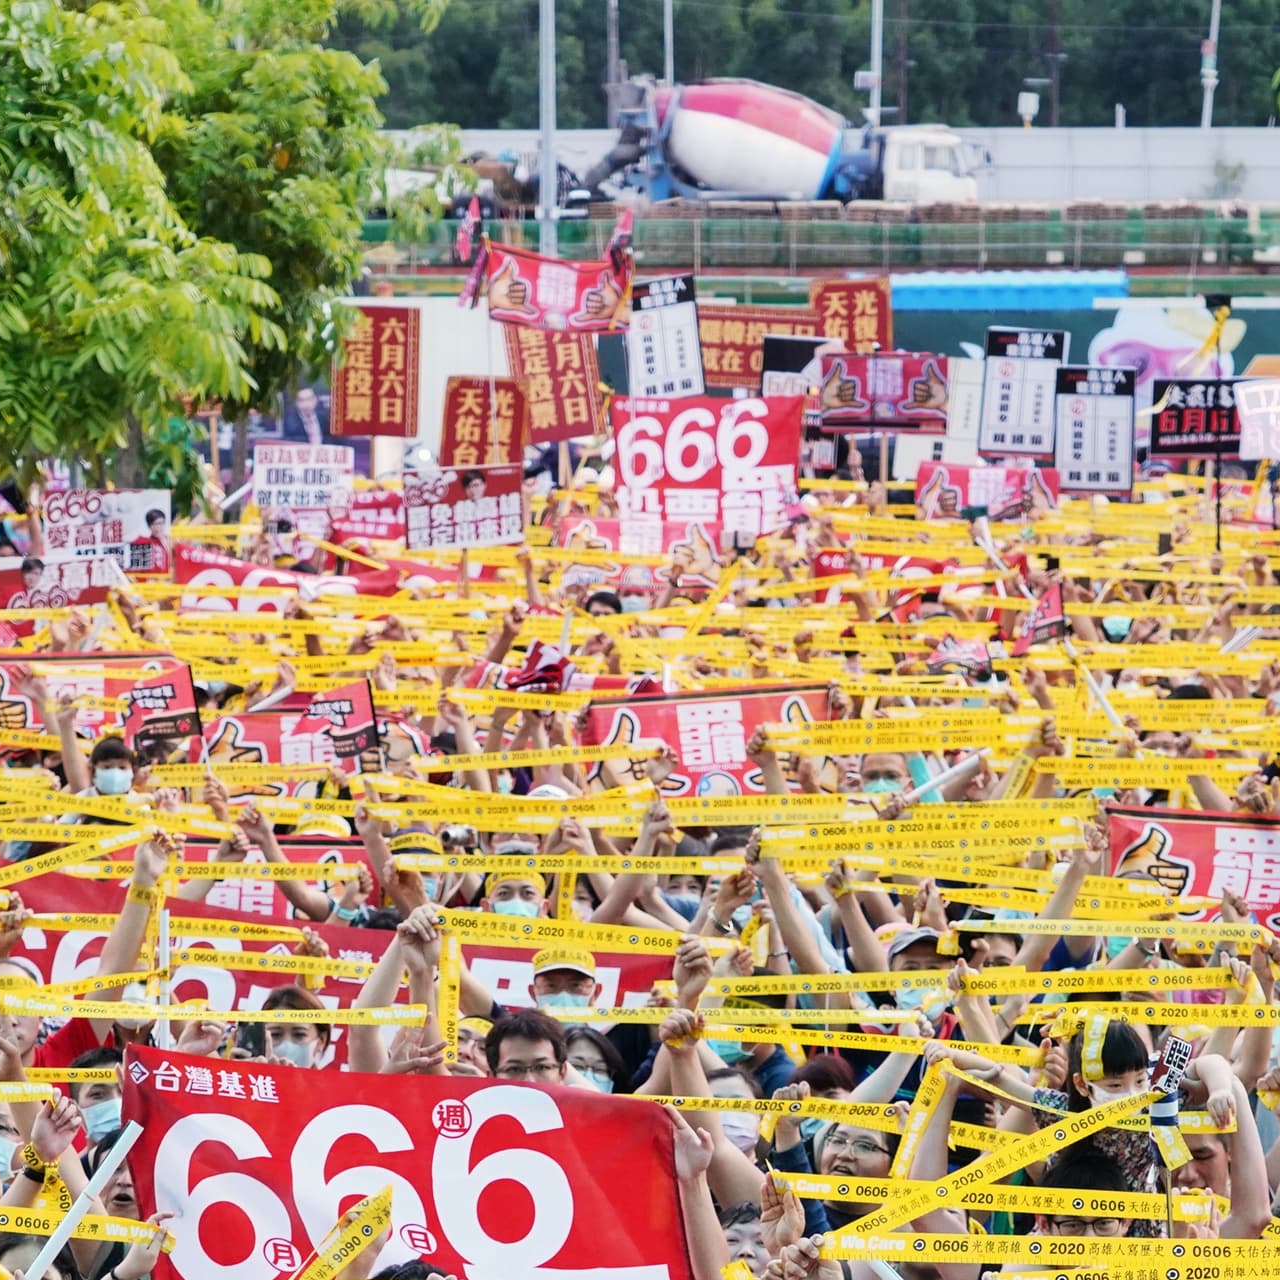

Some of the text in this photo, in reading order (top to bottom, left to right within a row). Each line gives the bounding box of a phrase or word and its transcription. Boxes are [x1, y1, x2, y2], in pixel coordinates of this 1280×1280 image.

[378, 317, 406, 423] 六月六日
[153, 1061, 280, 1103] 台灣基進
[437, 1101, 470, 1137] 週
[268, 1240, 301, 1271] 月
[405, 1225, 435, 1253] 日
[867, 1235, 906, 1251] Care
[933, 1239, 968, 1253] 0606
[970, 1239, 1021, 1255] 光復高雄
[1048, 1242, 1085, 1255] 2020
[1088, 1242, 1165, 1258] 高雄人寫歷史
[1192, 1245, 1231, 1258] 0606
